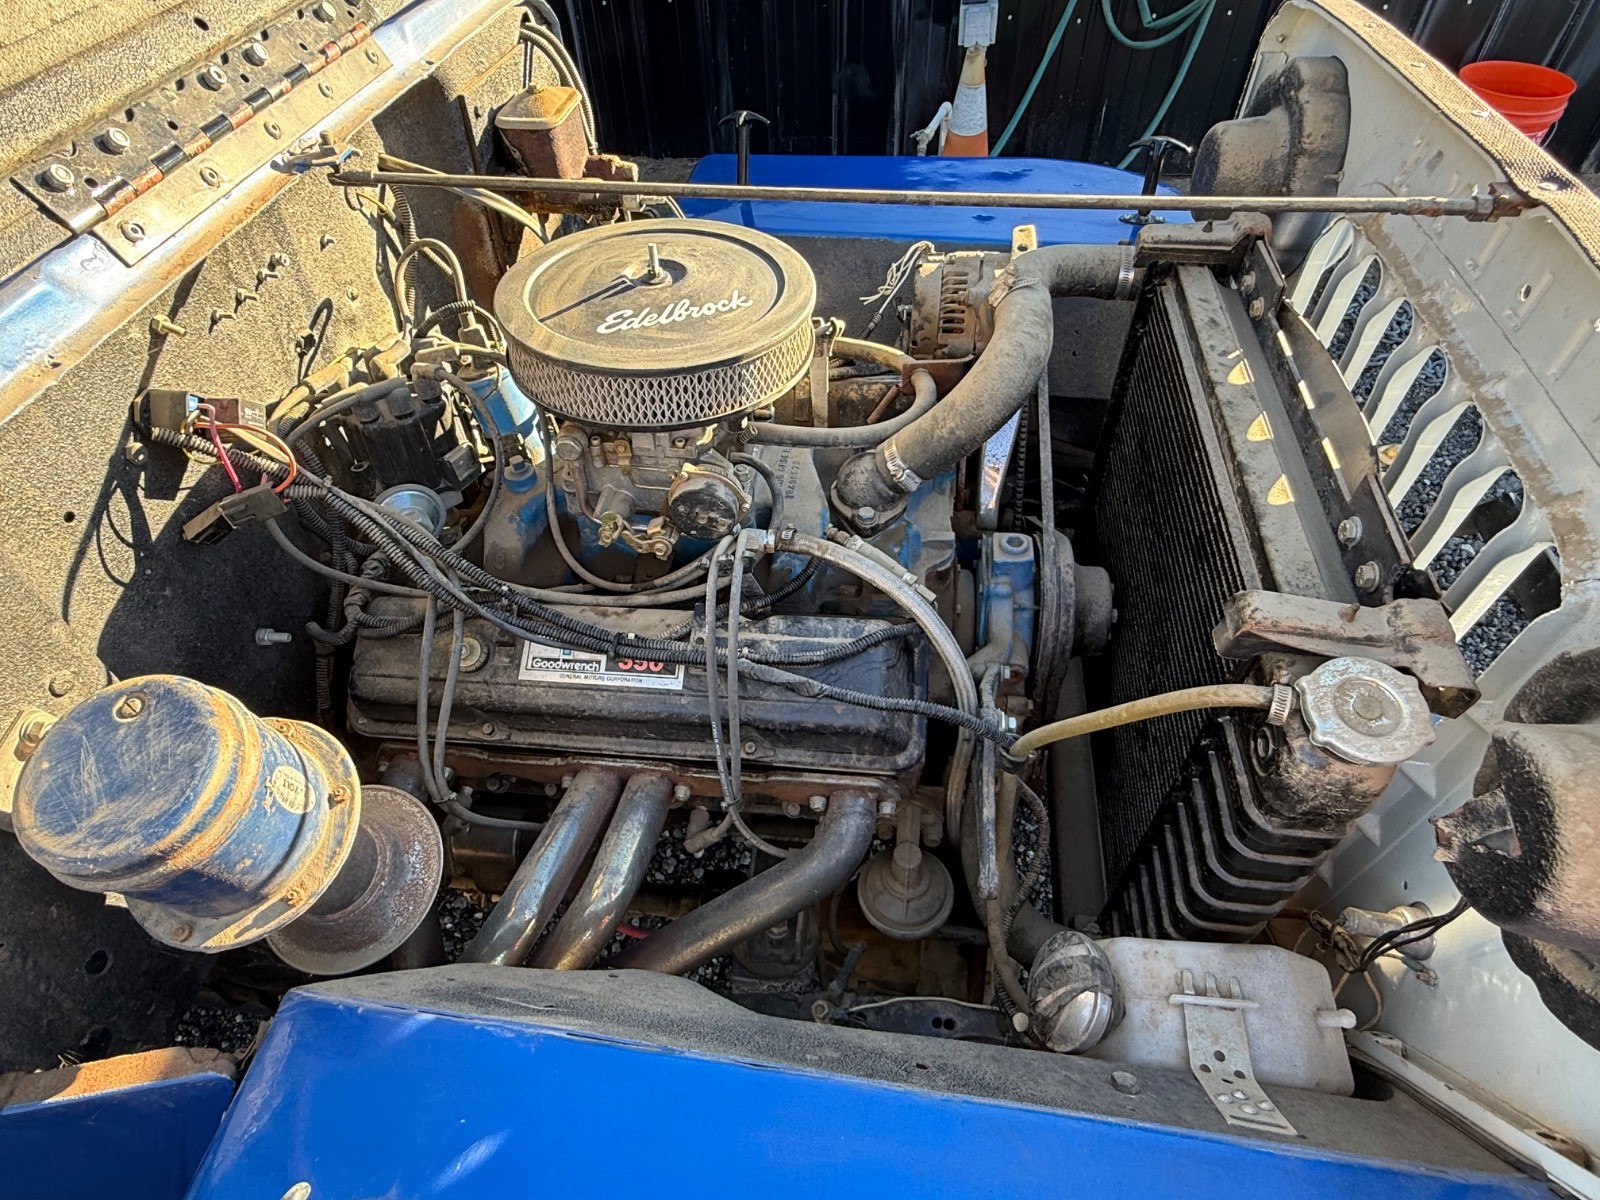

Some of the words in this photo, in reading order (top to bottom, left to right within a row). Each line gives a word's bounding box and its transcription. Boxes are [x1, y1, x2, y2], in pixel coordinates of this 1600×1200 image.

[596, 289, 754, 334] Edelbrock
[532, 658, 600, 672] Goodwrench
[584, 674, 605, 682] MOTORS
